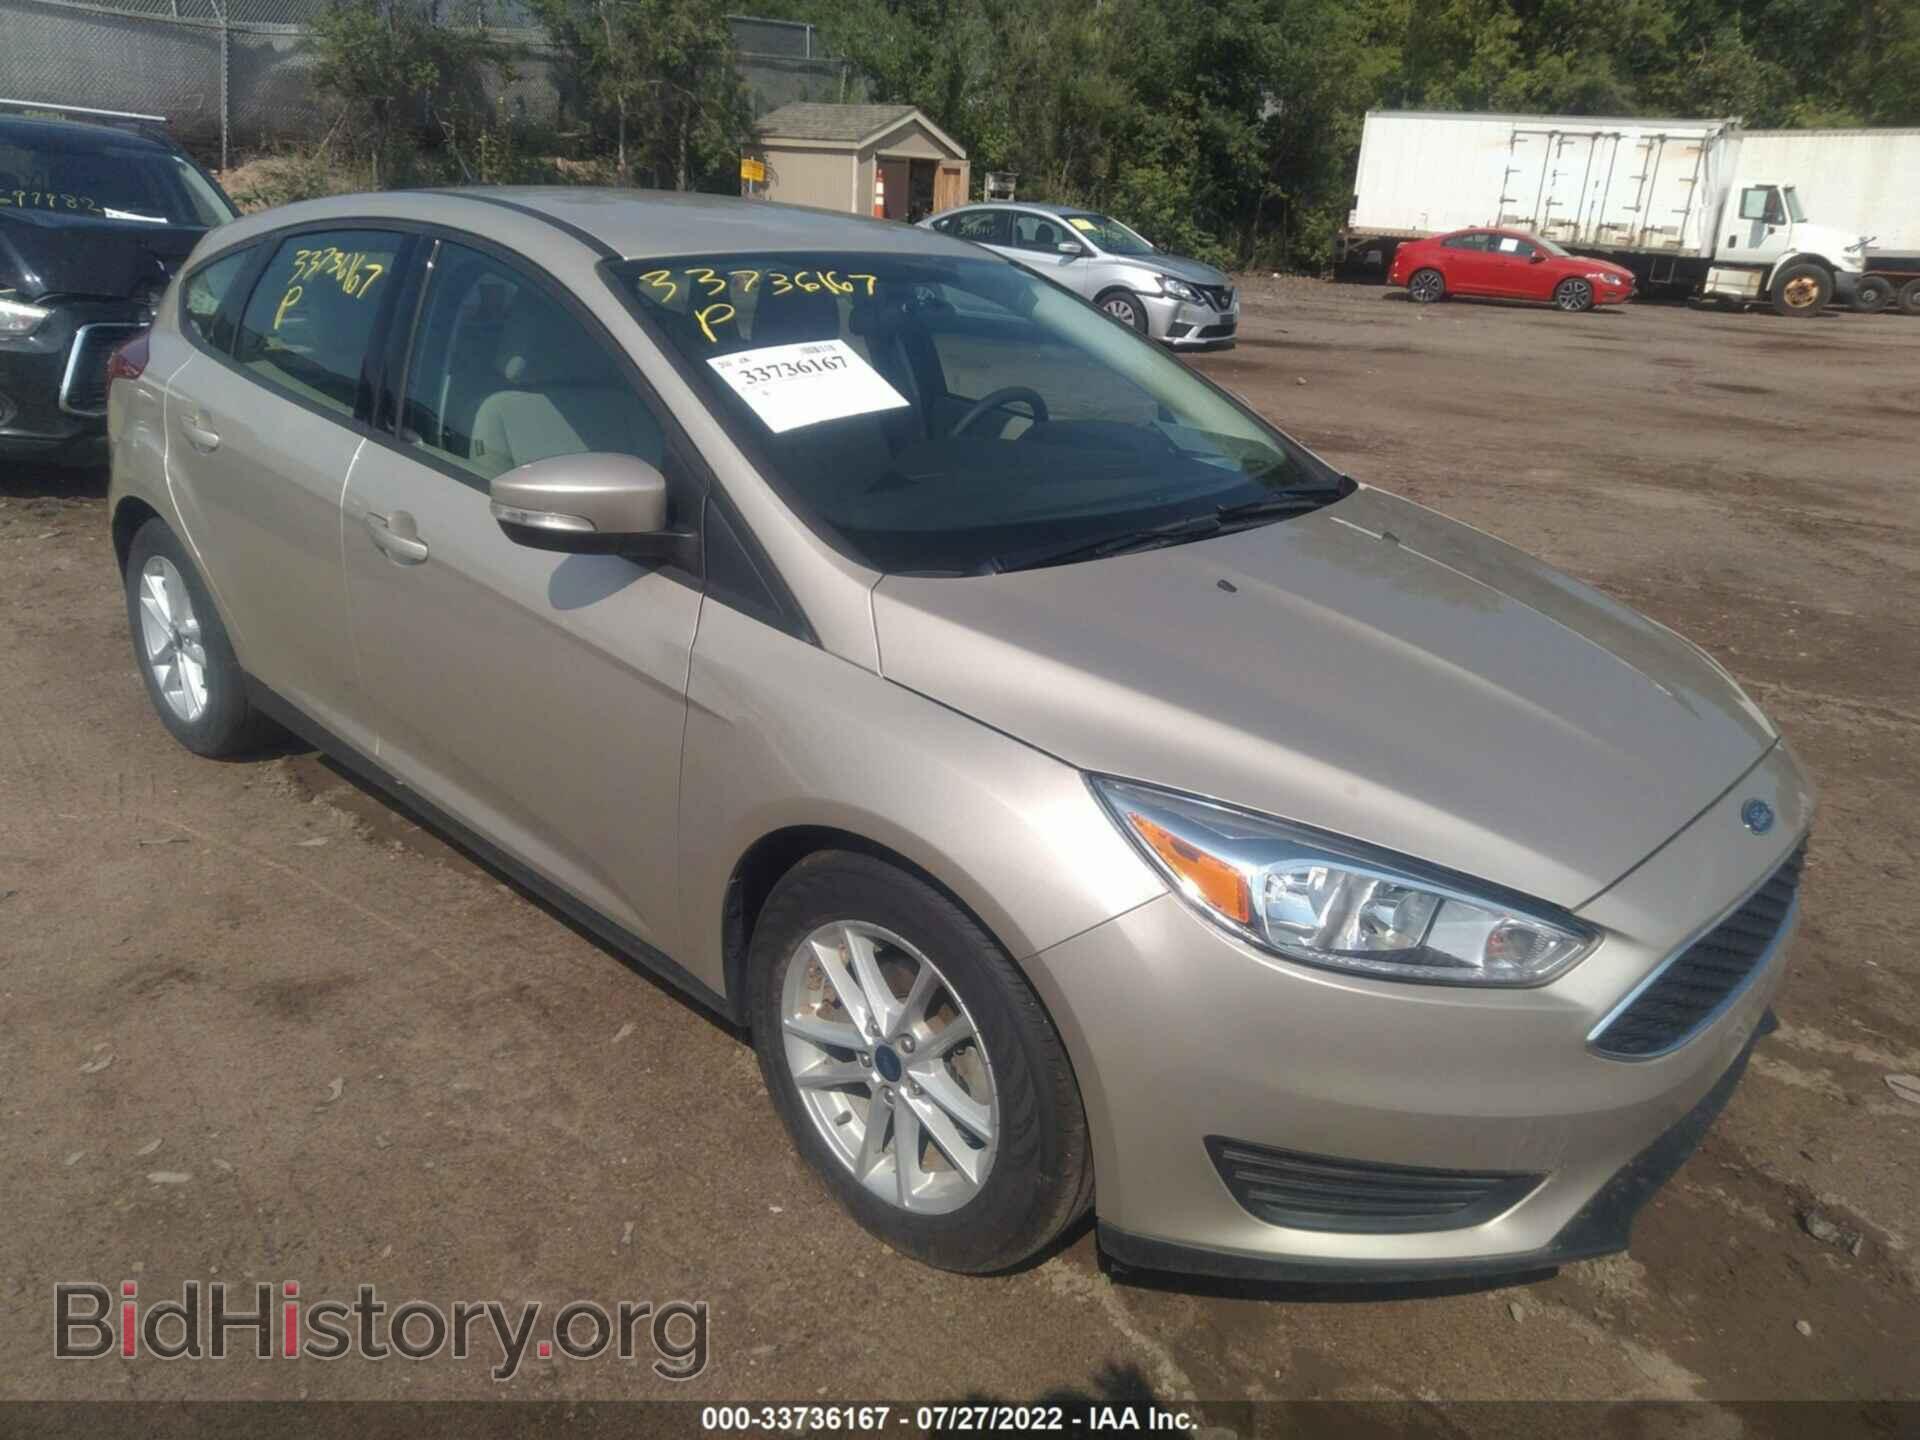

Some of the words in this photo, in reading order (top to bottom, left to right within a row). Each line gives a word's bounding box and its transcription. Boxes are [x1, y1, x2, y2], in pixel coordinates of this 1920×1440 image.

[288, 247, 384, 299] 33736167
[639, 268, 877, 303] 33736167
[273, 285, 303, 330] P
[694, 303, 735, 342] P
[738, 355, 848, 385] 33736167
